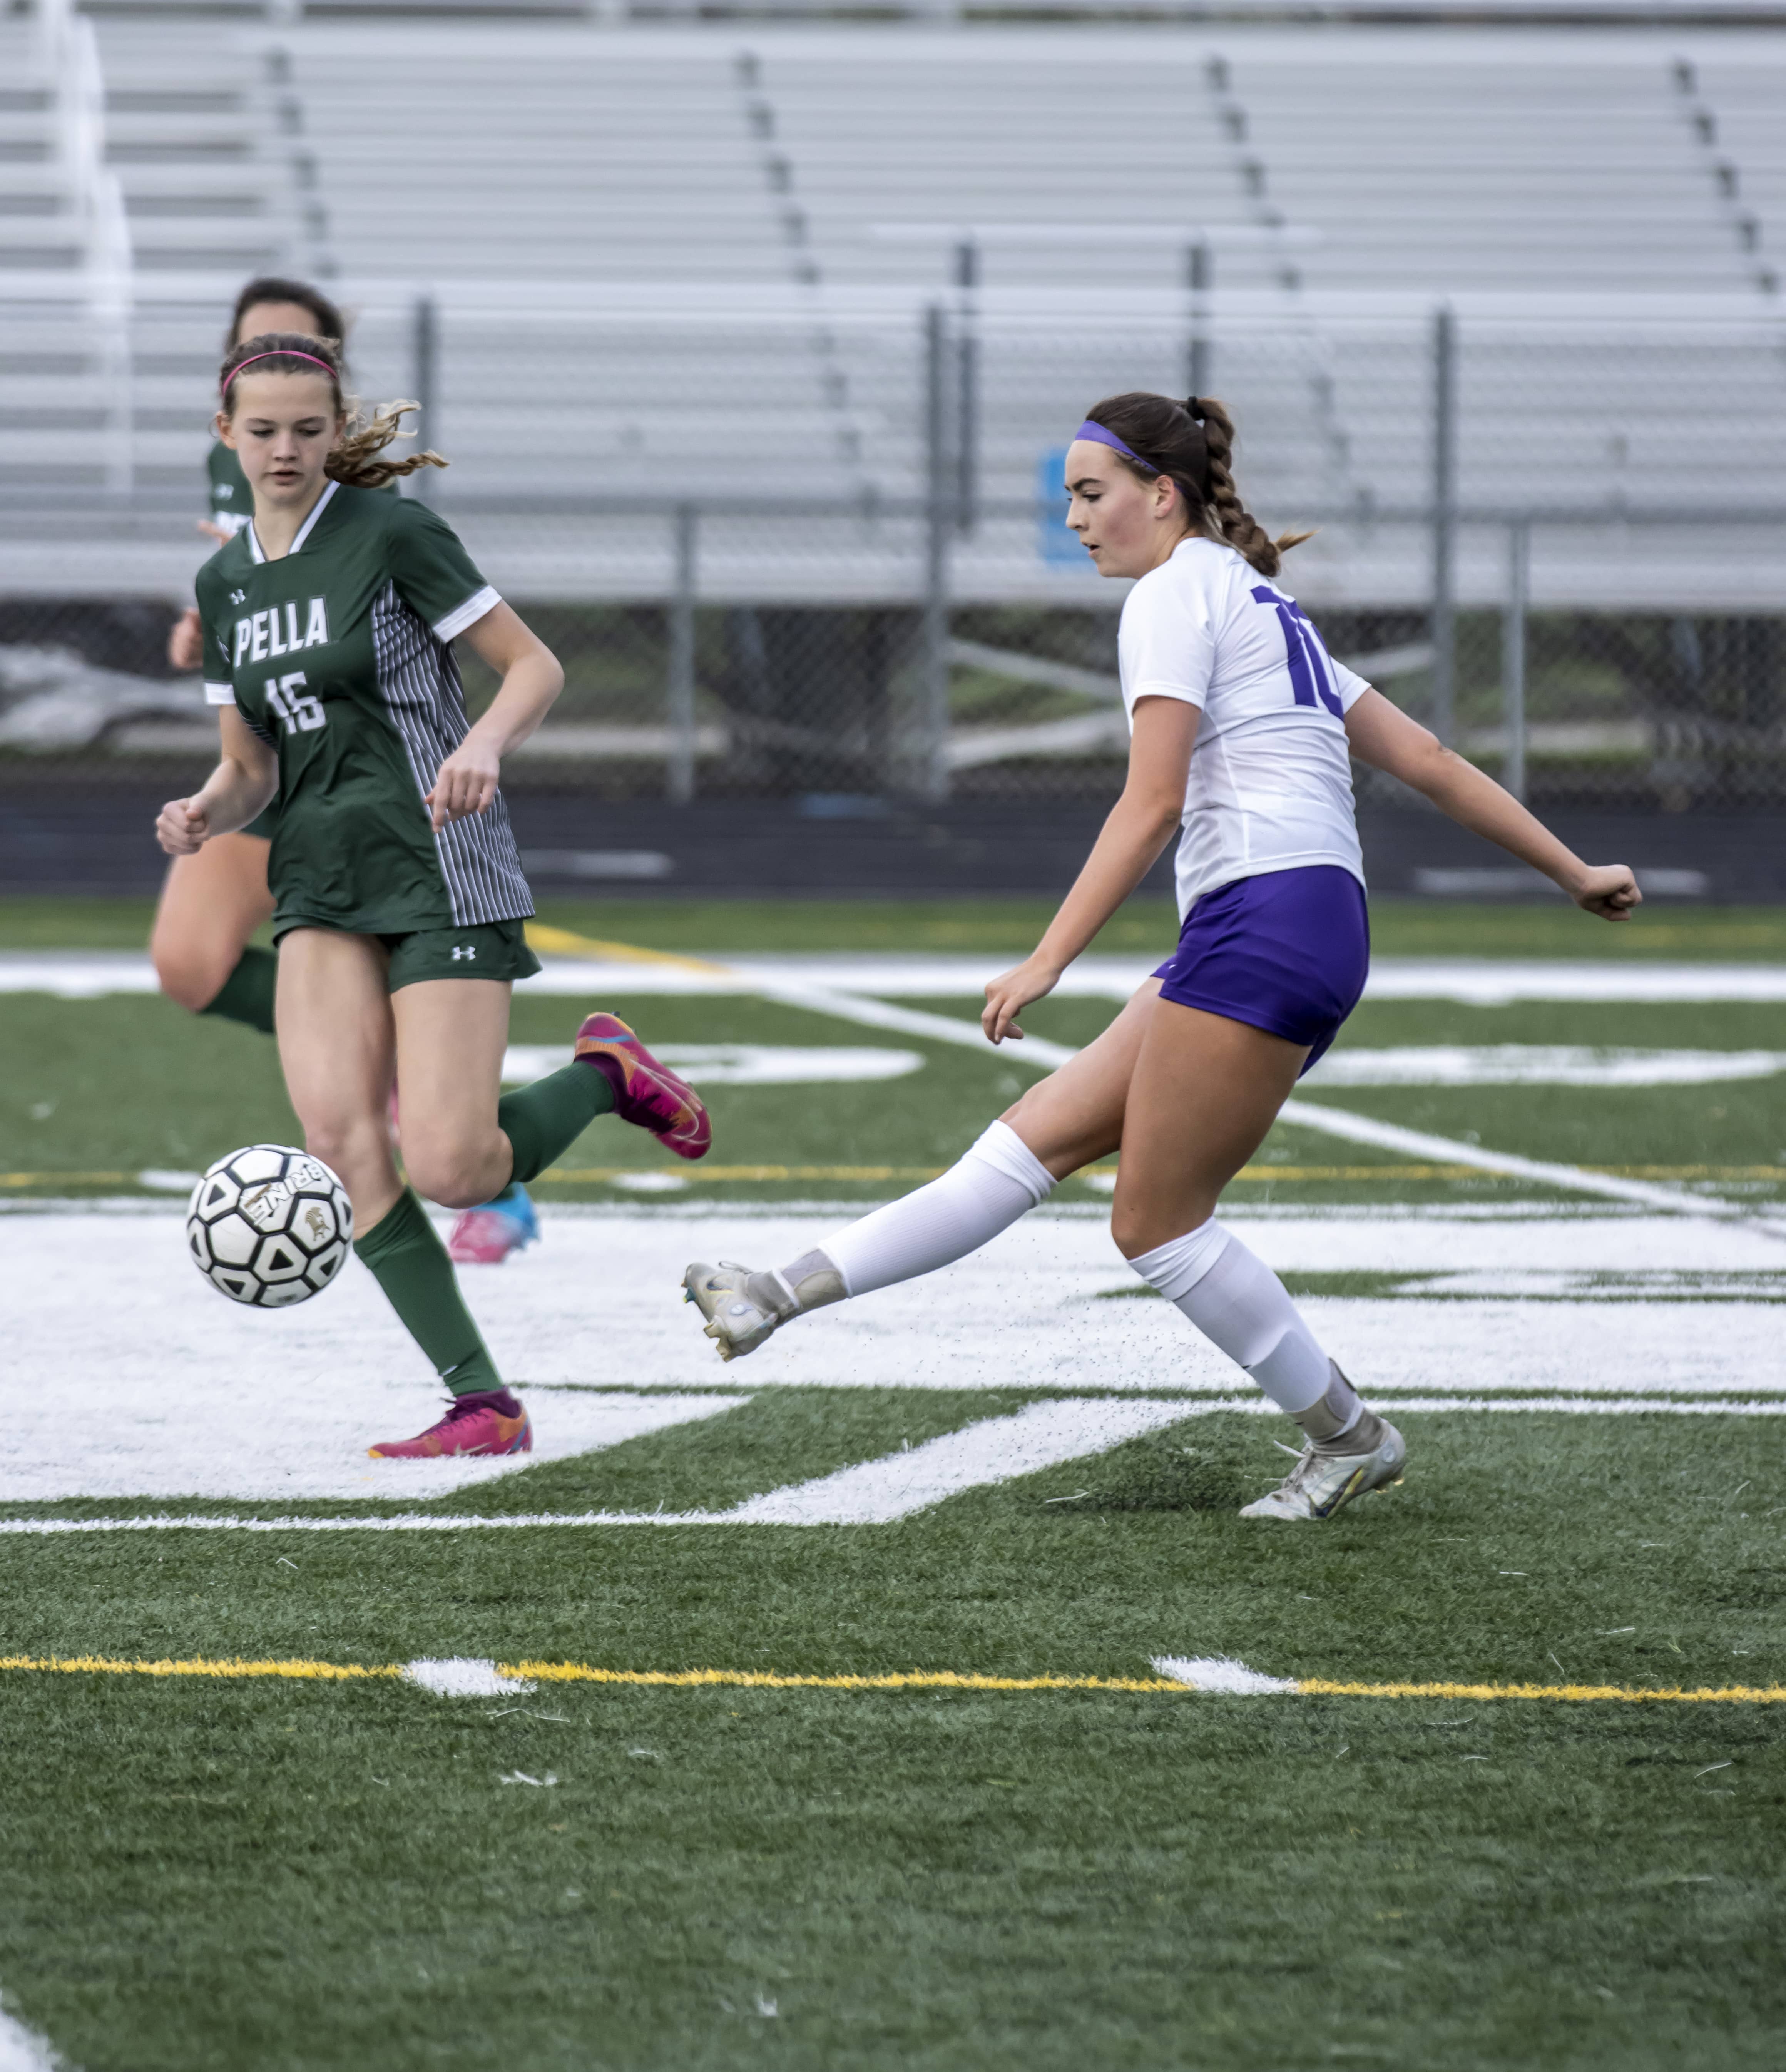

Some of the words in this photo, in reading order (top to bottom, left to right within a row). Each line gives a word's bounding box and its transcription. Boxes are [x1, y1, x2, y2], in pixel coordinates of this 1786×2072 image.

[234, 597, 328, 669] PELLA
[1250, 585, 1344, 722] 10
[248, 1163, 326, 1226] BRINE
